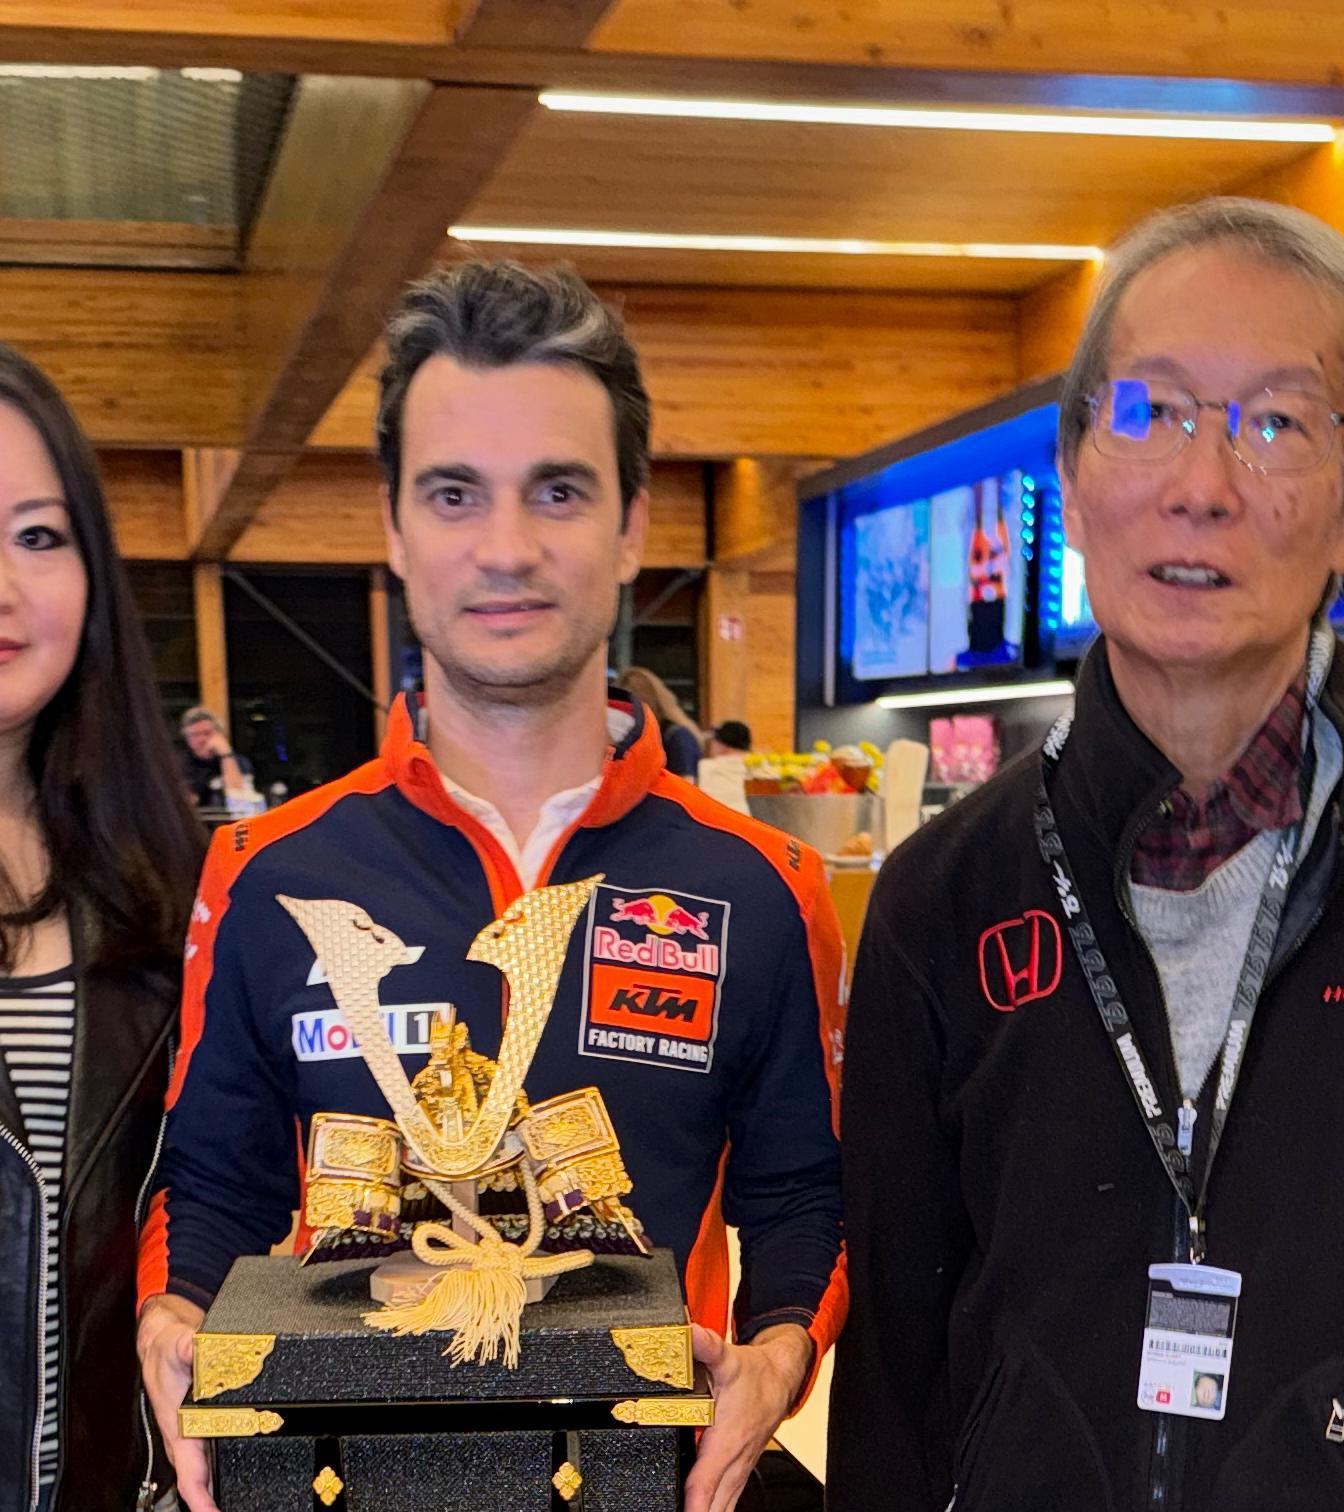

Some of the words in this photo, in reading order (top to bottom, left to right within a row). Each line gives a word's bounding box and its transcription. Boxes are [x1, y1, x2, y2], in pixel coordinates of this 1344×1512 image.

[593, 926, 658, 967] Red
[659, 938, 719, 976] Bull
[609, 983, 699, 1023] KTM
[299, 1012, 395, 1054] Mol
[414, 1013, 429, 1044] 1
[587, 1028, 656, 1054] FACTORY
[658, 1039, 709, 1063] RACING
